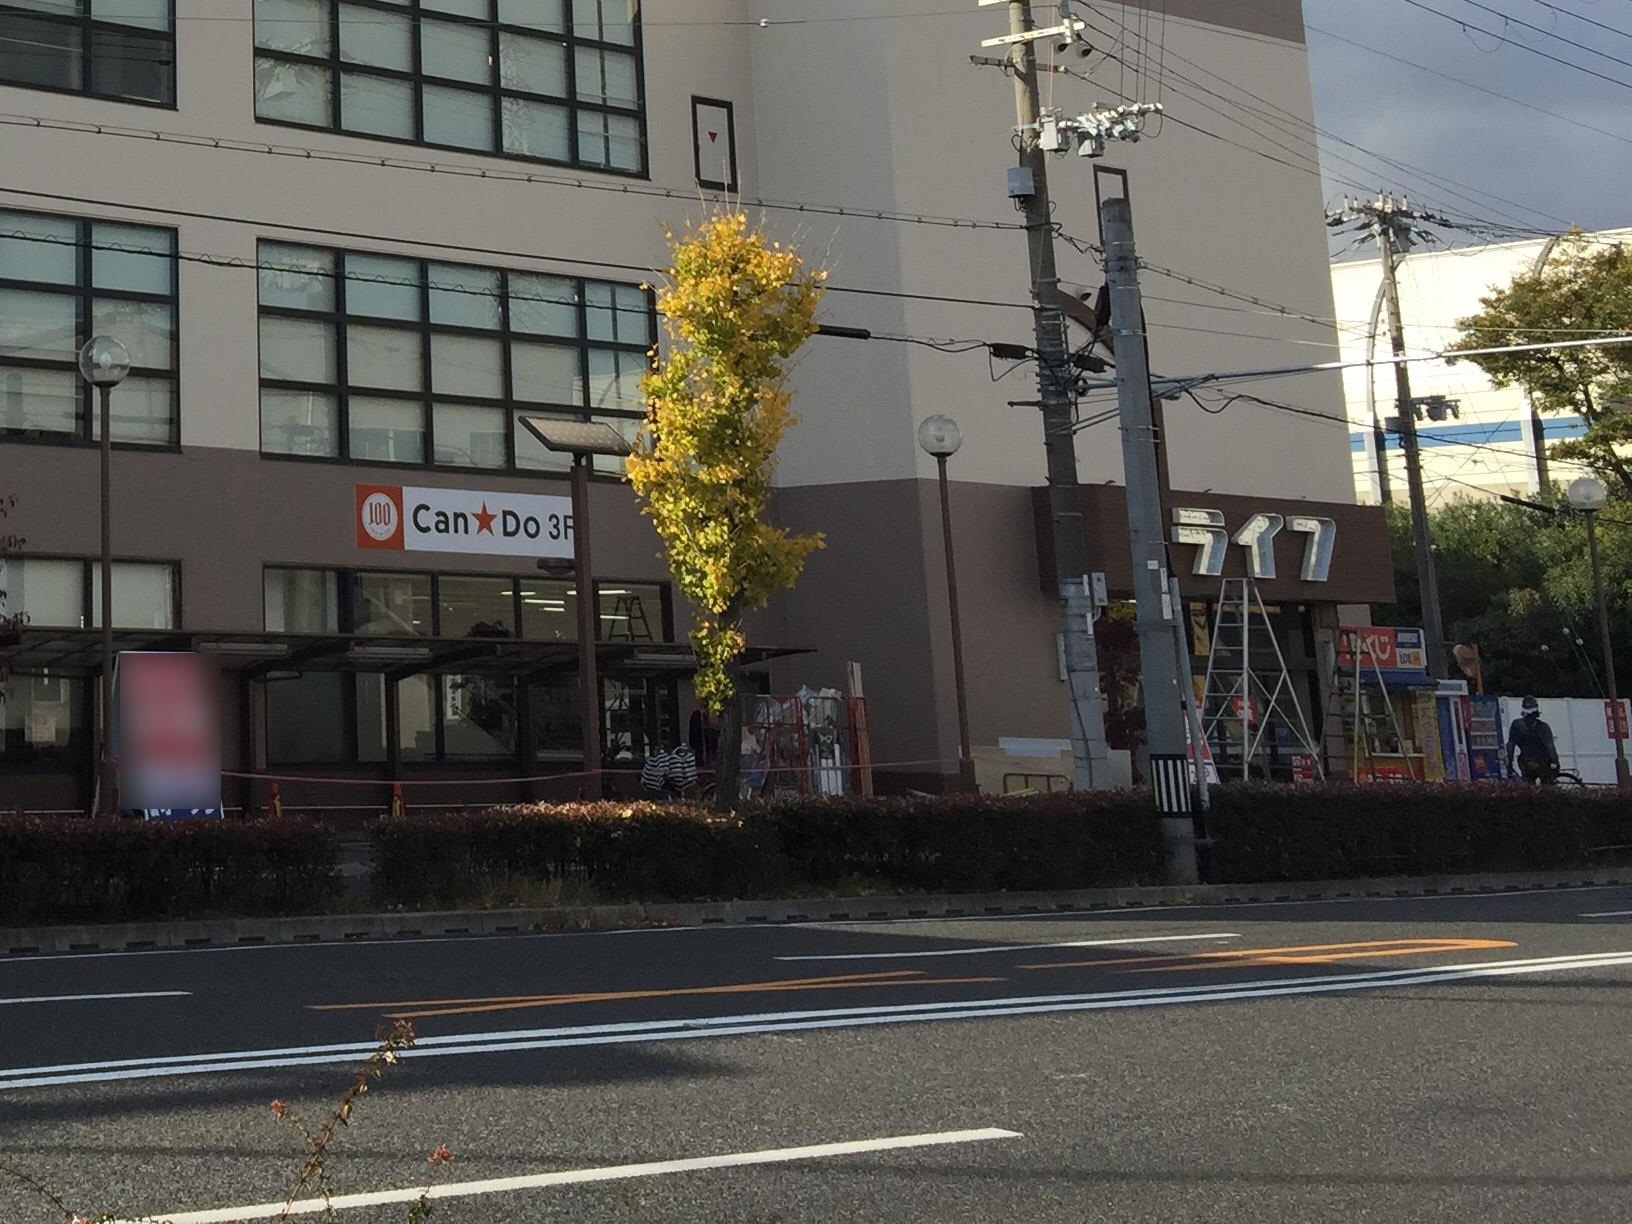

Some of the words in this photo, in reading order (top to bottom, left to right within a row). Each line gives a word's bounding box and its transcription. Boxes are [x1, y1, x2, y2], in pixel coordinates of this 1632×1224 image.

[368, 502, 391, 526] 100
[1171, 507, 1336, 582] ライフ
